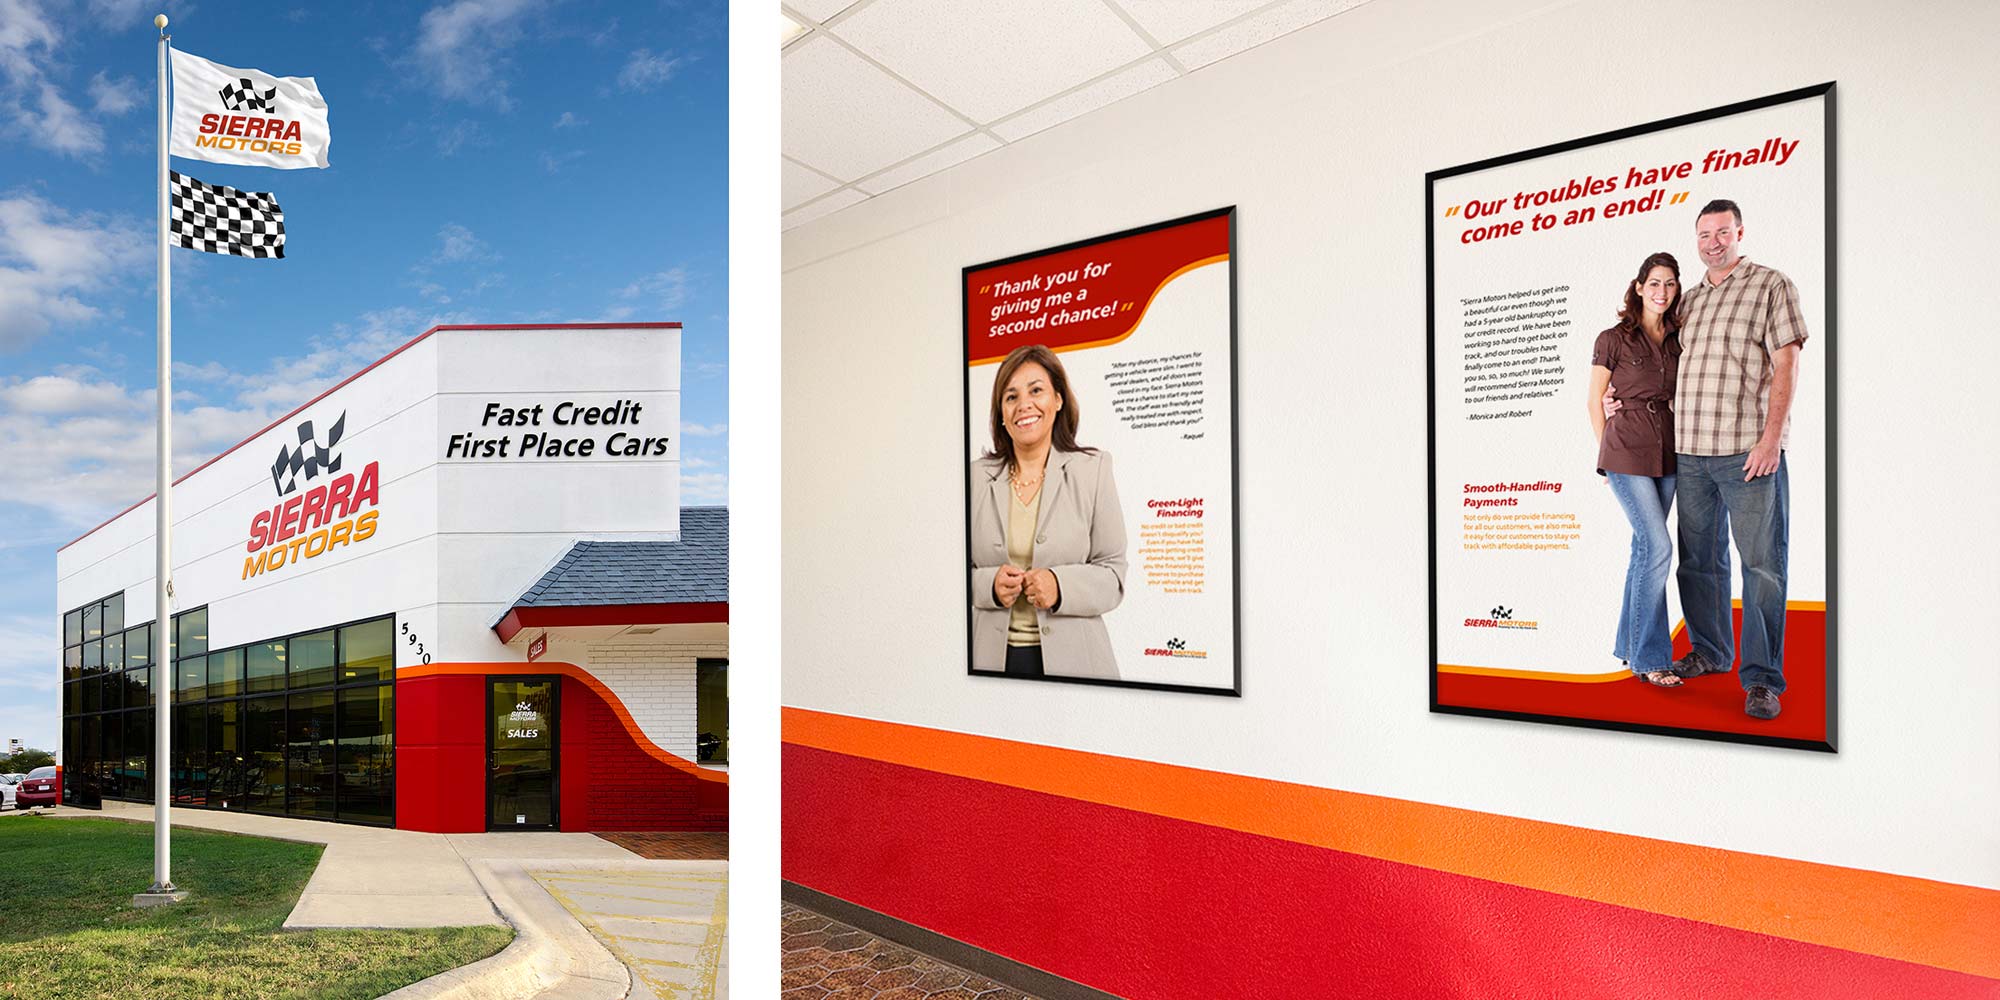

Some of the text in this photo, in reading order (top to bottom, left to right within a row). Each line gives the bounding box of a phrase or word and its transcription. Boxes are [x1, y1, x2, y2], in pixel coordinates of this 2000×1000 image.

[200, 114, 301, 141] SIERRA
[196, 136, 302, 155] MOTORS
[1513, 176, 1616, 211] troubles
[1625, 162, 1692, 189] have
[1701, 137, 1800, 174] finally
[1460, 221, 1523, 243] come
[1531, 213, 1556, 231] to
[1564, 207, 1594, 224] an
[1046, 269, 1078, 291] you
[1082, 261, 1111, 279] for
[1483, 294, 1506, 302] Motors
[1508, 290, 1531, 299] helped
[1542, 287, 1553, 296] get
[990, 289, 1087, 321] giving me a
[1470, 306, 1498, 315] beautiful
[1529, 298, 1554, 307] though
[1517, 310, 1556, 320] bankruptcy
[989, 313, 1047, 337] second
[1464, 341, 1491, 349] working
[1527, 335, 1538, 343] get
[1544, 366, 1565, 374] surely
[1477, 381, 1517, 391] recommend
[482, 400, 642, 426] Fast Credit
[447, 432, 669, 458] First Place Cars
[1464, 481, 1562, 493] Smooth-Handling
[247, 461, 379, 552] SIERRA
[1148, 497, 1203, 508] Green-Light
[1464, 498, 1518, 508] Payments
[1157, 509, 1203, 518] Financing
[242, 509, 379, 580] MOTORS
[1464, 619, 1497, 628] SIERRA
[531, 640, 543, 658] SALES
[508, 729, 538, 738] SALES
